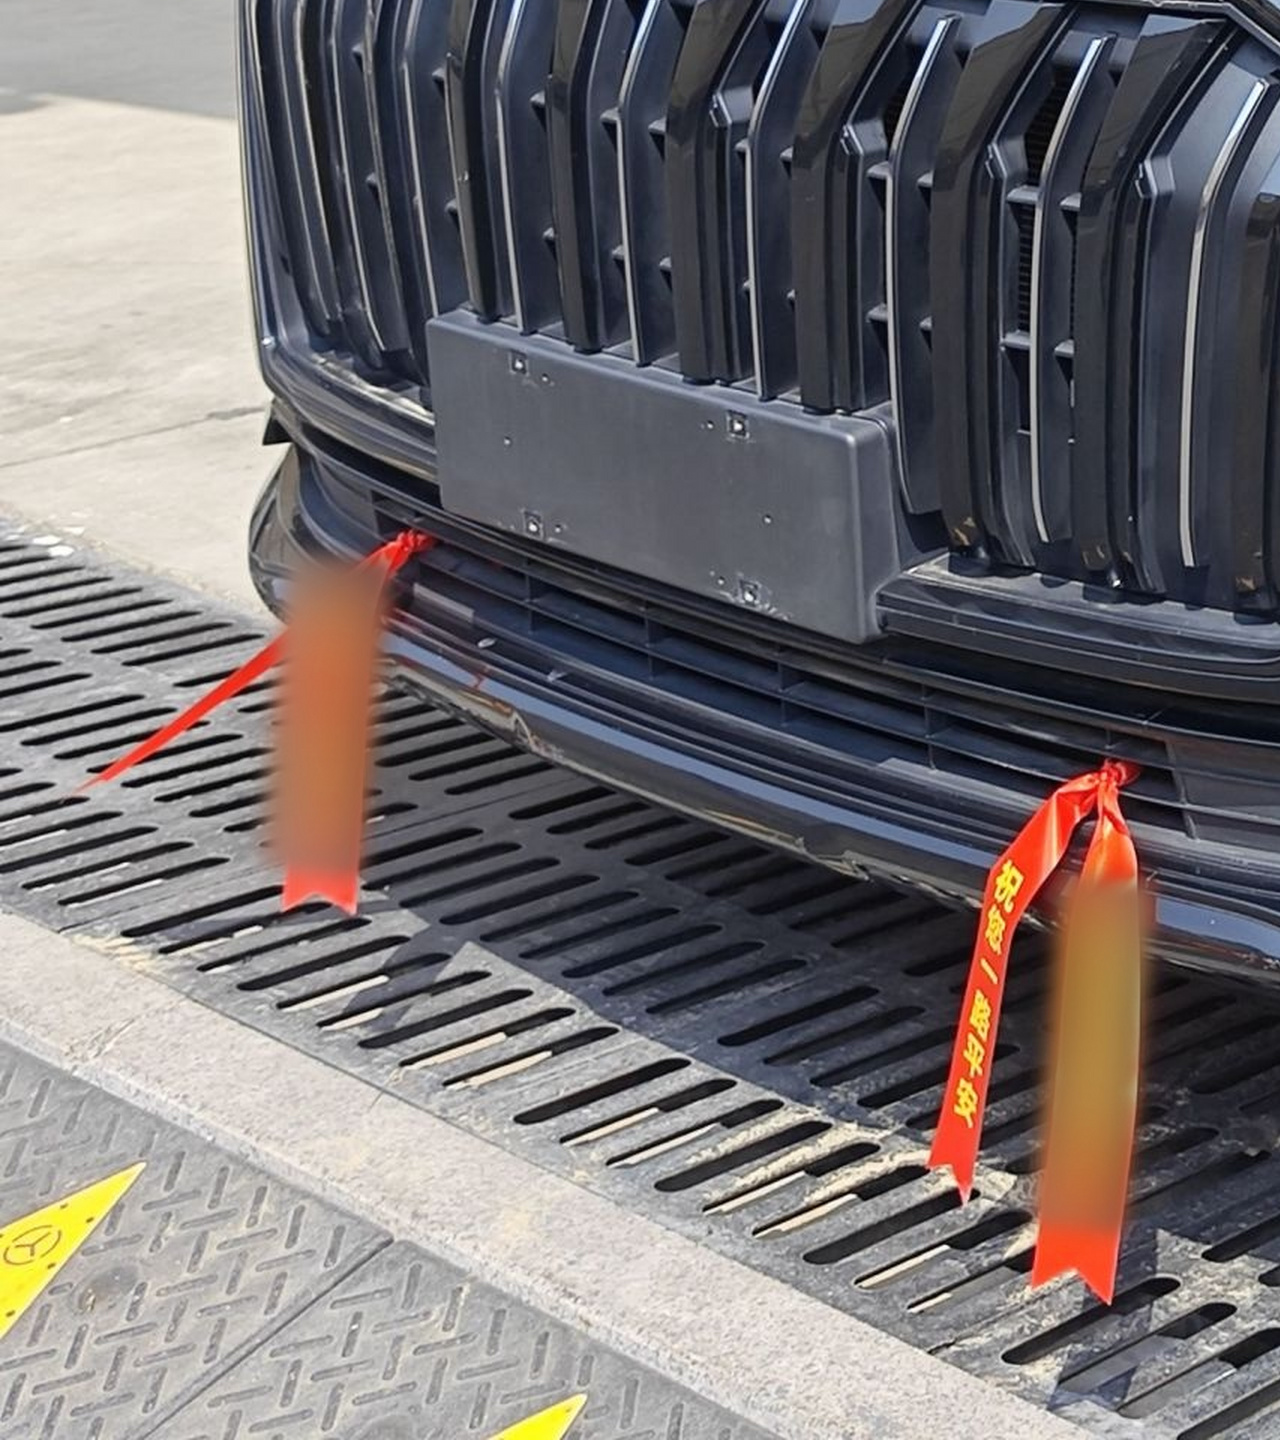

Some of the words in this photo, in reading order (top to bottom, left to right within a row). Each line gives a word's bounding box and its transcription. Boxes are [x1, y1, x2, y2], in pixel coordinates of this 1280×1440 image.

[954, 859, 1024, 1128] 祝您一路平安
